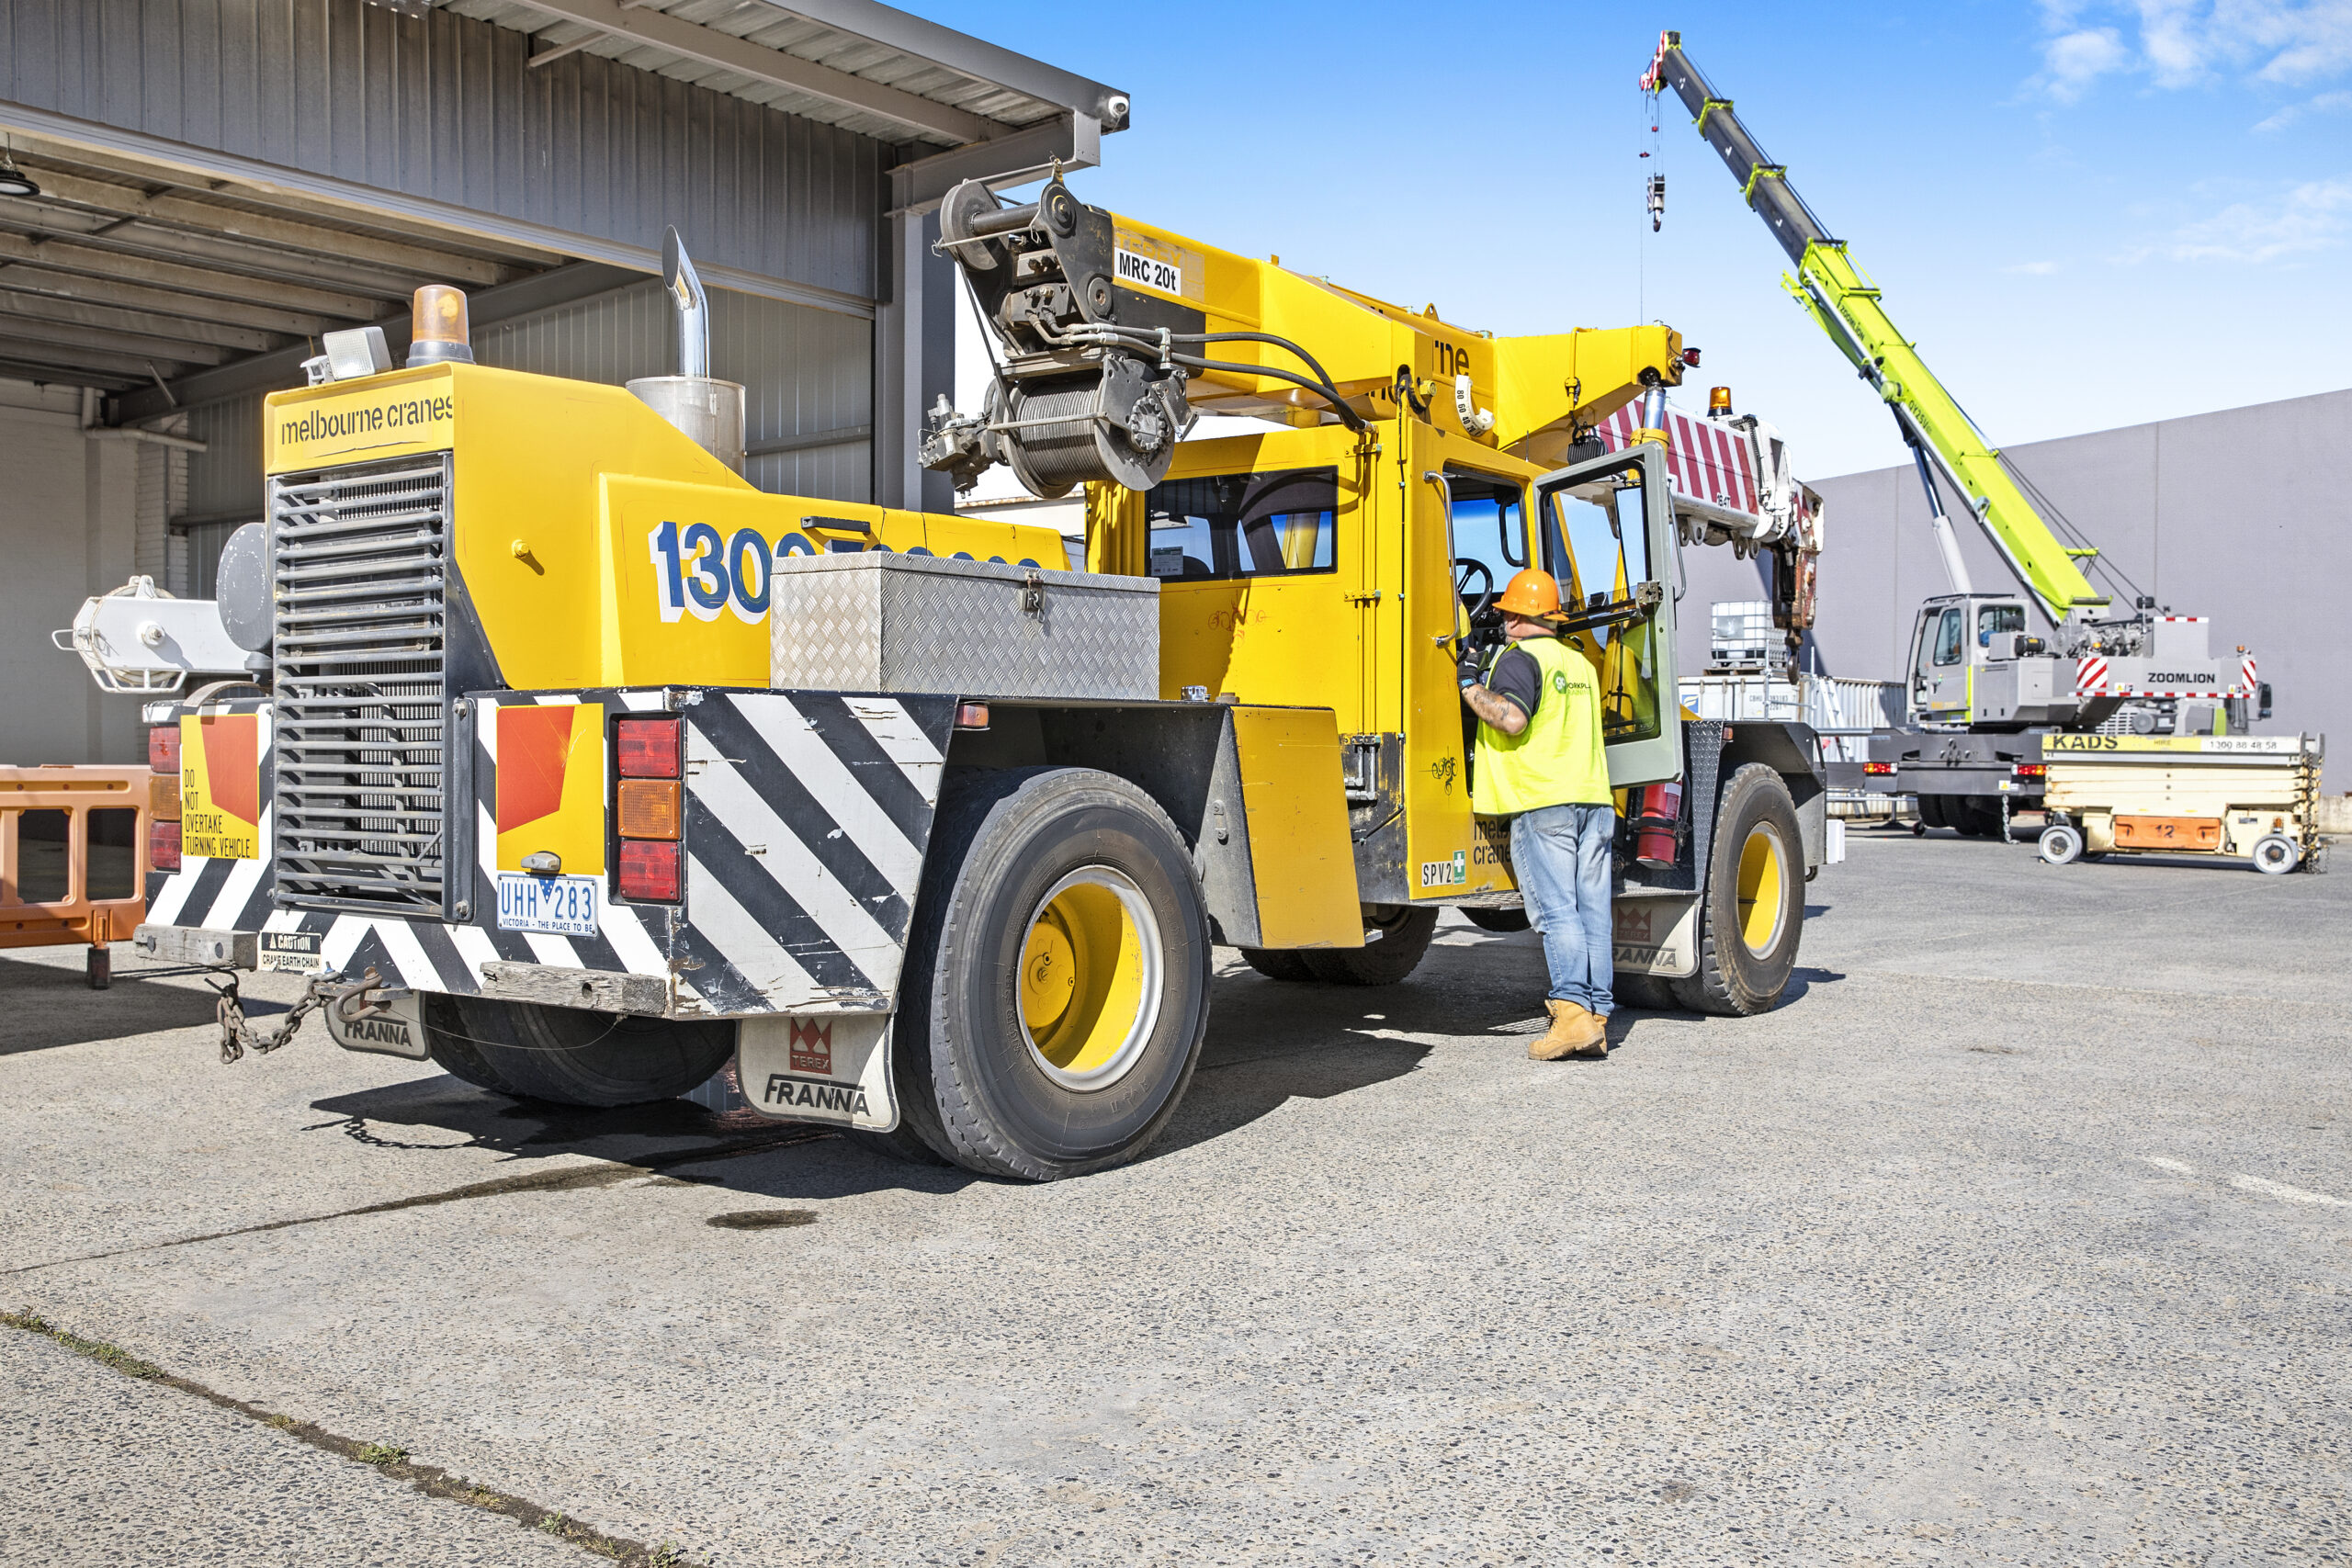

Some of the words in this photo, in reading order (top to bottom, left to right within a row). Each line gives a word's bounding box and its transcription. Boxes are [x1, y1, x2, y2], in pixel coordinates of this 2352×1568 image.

[1119, 252, 1150, 282] MRC
[1154, 264, 1176, 291] 20t
[1456, 389, 1464, 400] 80
[1458, 403, 1466, 413] 60
[281, 406, 382, 446] melbourne
[387, 395, 452, 427] cranes
[1463, 416, 1471, 425] 40
[647, 521, 817, 625] 130
[2147, 672, 2215, 683] ZOOMLION
[2052, 735, 2119, 750] KADS
[185, 769, 195, 788] DO
[185, 791, 198, 810] NOT
[185, 813, 223, 834] OVERTAKE
[2155, 824, 2175, 838] 12
[186, 836, 217, 856] TURNING
[220, 838, 251, 859] VEHICLE
[1473, 844, 1511, 865] crane
[1423, 863, 1452, 886] SPV2
[501, 882, 537, 918] UHH
[554, 885, 592, 921] 283
[503, 919, 529, 928] VICTORIA
[537, 920, 549, 930] THE
[551, 922, 571, 931] PLACE
[573, 923, 582, 931] TO
[584, 923, 593, 932] BE
[277, 934, 311, 951] CAUTION
[282, 955, 301, 967] EARTH
[301, 956, 320, 968] CHAIN
[1612, 943, 1677, 968] RANNA
[344, 1015, 413, 1047] FRANNA
[792, 1055, 830, 1070] TEREX
[763, 1074, 871, 1117] FRANNA
